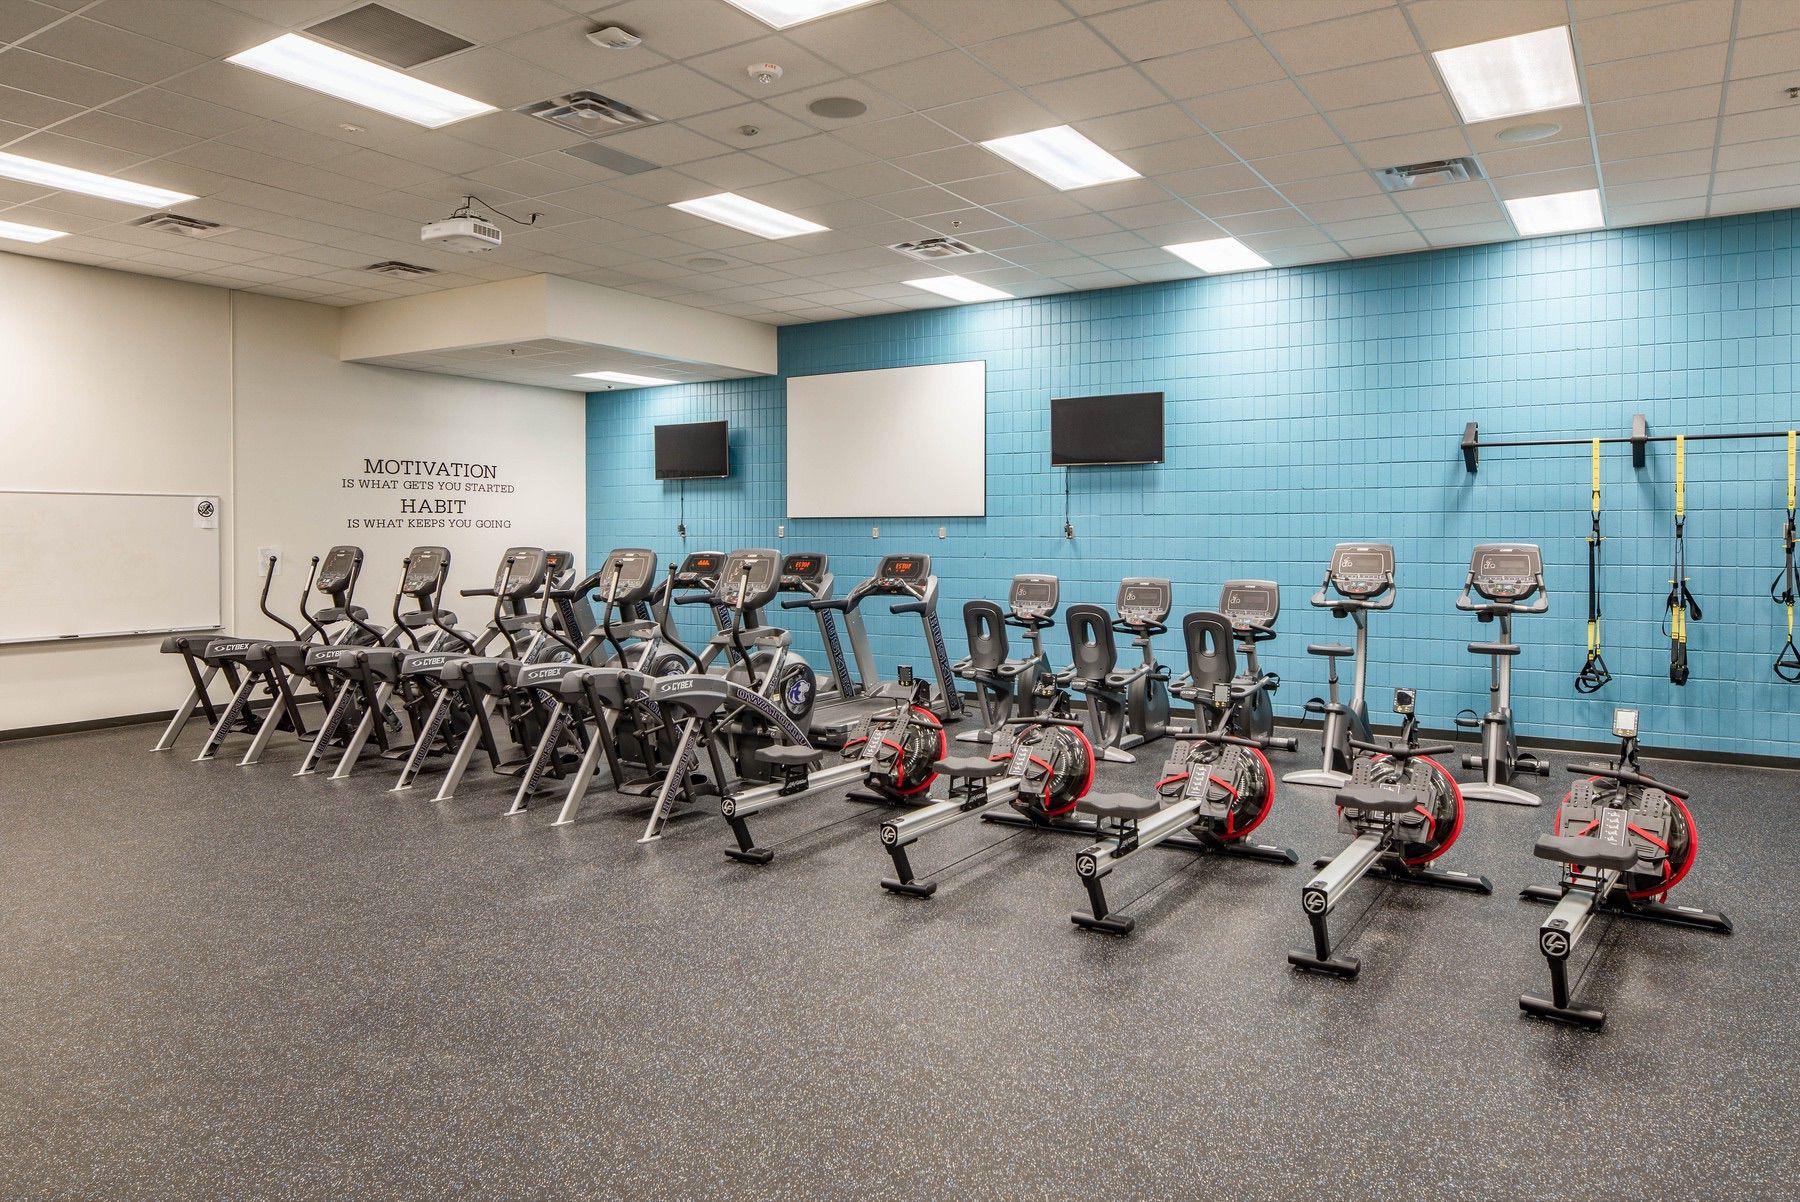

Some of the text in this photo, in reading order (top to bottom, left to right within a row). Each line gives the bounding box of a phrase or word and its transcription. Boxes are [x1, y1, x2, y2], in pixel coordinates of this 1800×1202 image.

[364, 458, 497, 479] MOTIVATION
[342, 478, 515, 493] IS WHAT GETS YOU STARTED
[400, 498, 466, 514] HABIT
[347, 519, 511, 529] IS WHAT KEEPS YOU GOING
[226, 643, 249, 651] CYBEX
[327, 650, 341, 658] CYB
[423, 656, 445, 665] CYBEX
[539, 667, 561, 677] CYBEX
[672, 680, 693, 690] CYBEX
